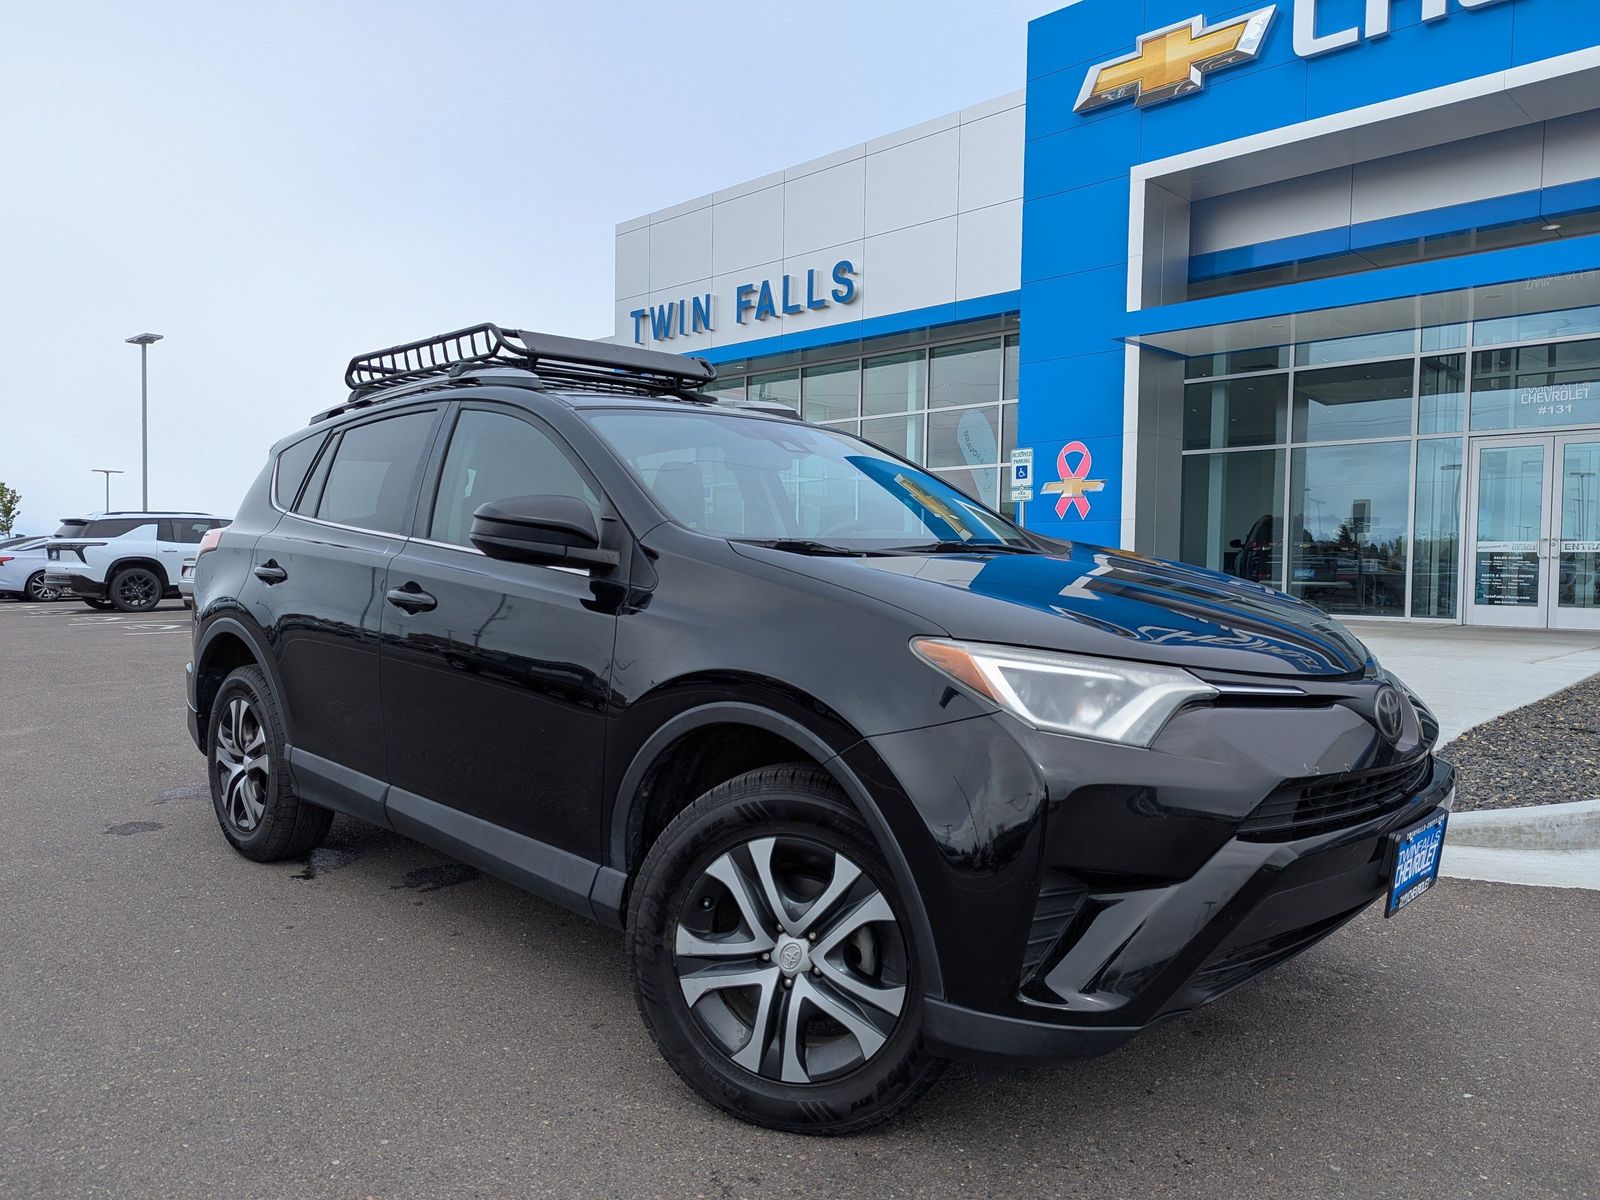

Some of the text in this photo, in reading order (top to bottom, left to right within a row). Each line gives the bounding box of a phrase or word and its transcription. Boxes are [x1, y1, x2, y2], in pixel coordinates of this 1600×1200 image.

[630, 260, 859, 345] TWIN FALLS
[1521, 388, 1590, 404] CHEVROLET
[1537, 404, 1572, 415] #131
[1394, 843, 1439, 889] CHEVROLET
